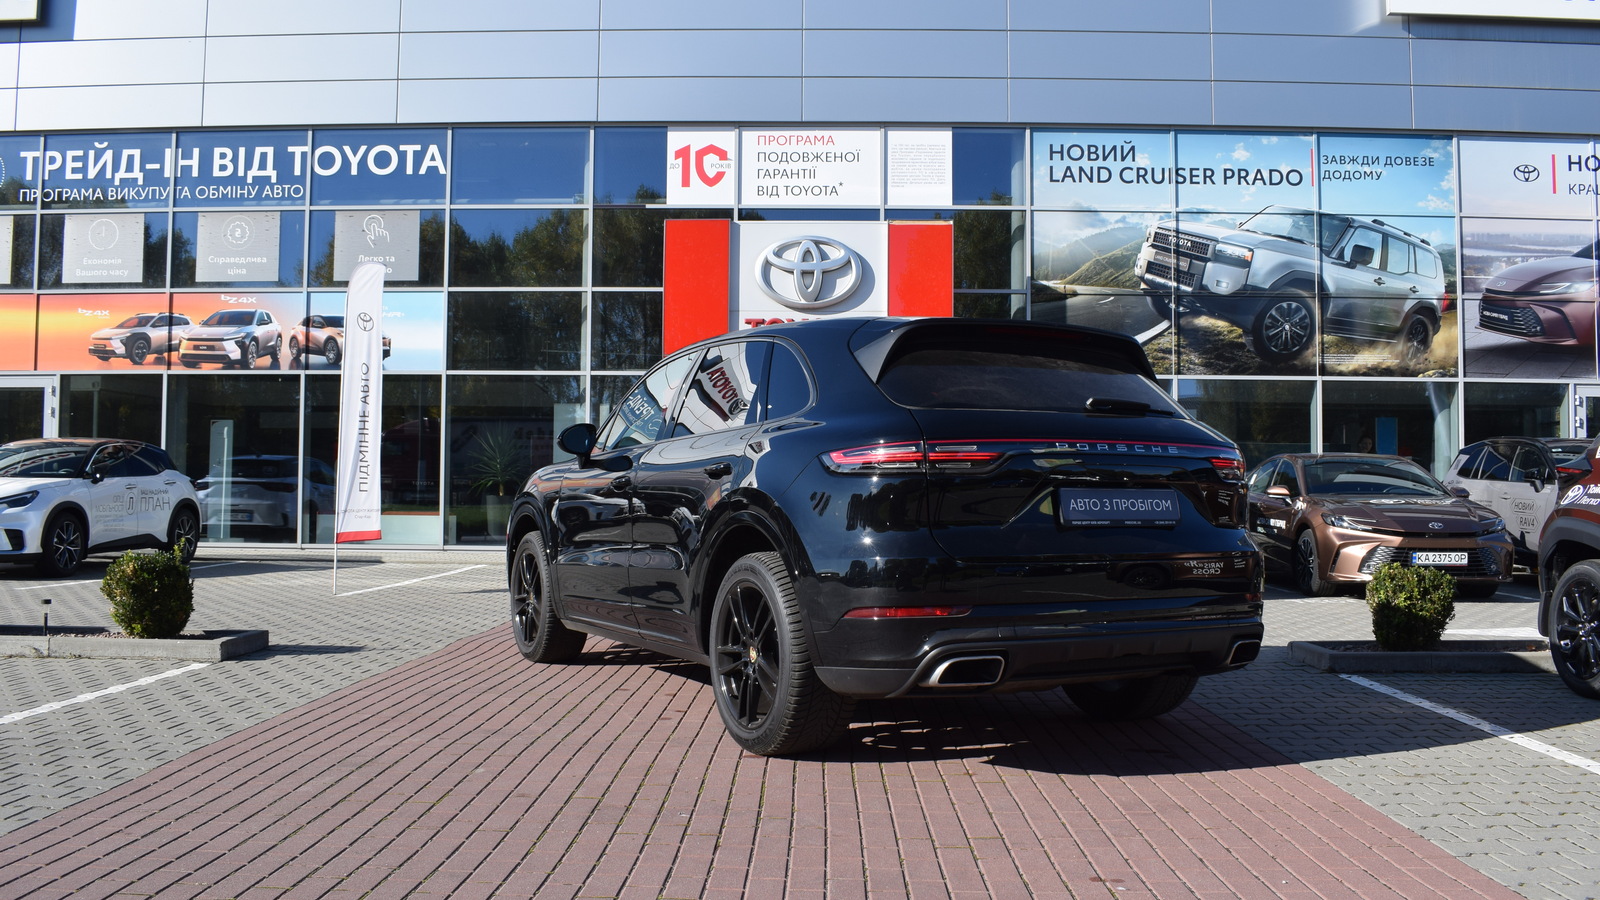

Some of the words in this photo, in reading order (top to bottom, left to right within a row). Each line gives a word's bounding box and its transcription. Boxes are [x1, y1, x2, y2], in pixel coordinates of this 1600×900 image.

[757, 134, 835, 146] ПРОГРАМА
[757, 149, 861, 164] ПОДОВЖЕНОЇ
[1049, 140, 1136, 162] НОВИЙ
[20, 141, 200, 185] ТРЕЙД-ІН
[213, 146, 277, 183] ВІД
[288, 144, 447, 176] TOYOTA
[1322, 154, 1380, 167] ЗАВЖДИ
[1383, 155, 1435, 168] ДОВЕЗЕ
[757, 166, 817, 179] ГАРАНТІЇ
[1049, 165, 1113, 183] LAND
[1119, 166, 1216, 185] CRUISER
[1223, 168, 1304, 187] PRADO
[1322, 169, 1383, 182] ДОДОМУ
[19, 187, 103, 202] ПРОГРАМА
[108, 187, 170, 200] ВИКУПУ
[175, 186, 191, 199] ТА
[195, 185, 259, 199] ОБМІНУ
[262, 184, 304, 198] АВТО
[757, 185, 780, 198] ВІД
[83, 257, 122, 265] Економія
[208, 255, 267, 265] Справедлива
[358, 254, 384, 263] Легко
[76, 268, 107, 277] Вашого
[109, 268, 129, 278] часу
[227, 266, 247, 276] ціна
[360, 362, 370, 405] АВТО
[358, 410, 370, 493] ПІДМІННЕ
[1055, 442, 1179, 454] PORSCHE
[140, 496, 171, 512] ПЛАН
[1069, 498, 1100, 511] АВТО
[1113, 499, 1172, 511] ПРОБІГОМ
[1513, 501, 1535, 512] НОВИЙ
[1519, 516, 1535, 527] RAV4
[1417, 553, 1430, 563] KA
[1431, 553, 1453, 563] 2375
[1454, 553, 1467, 563] OP
